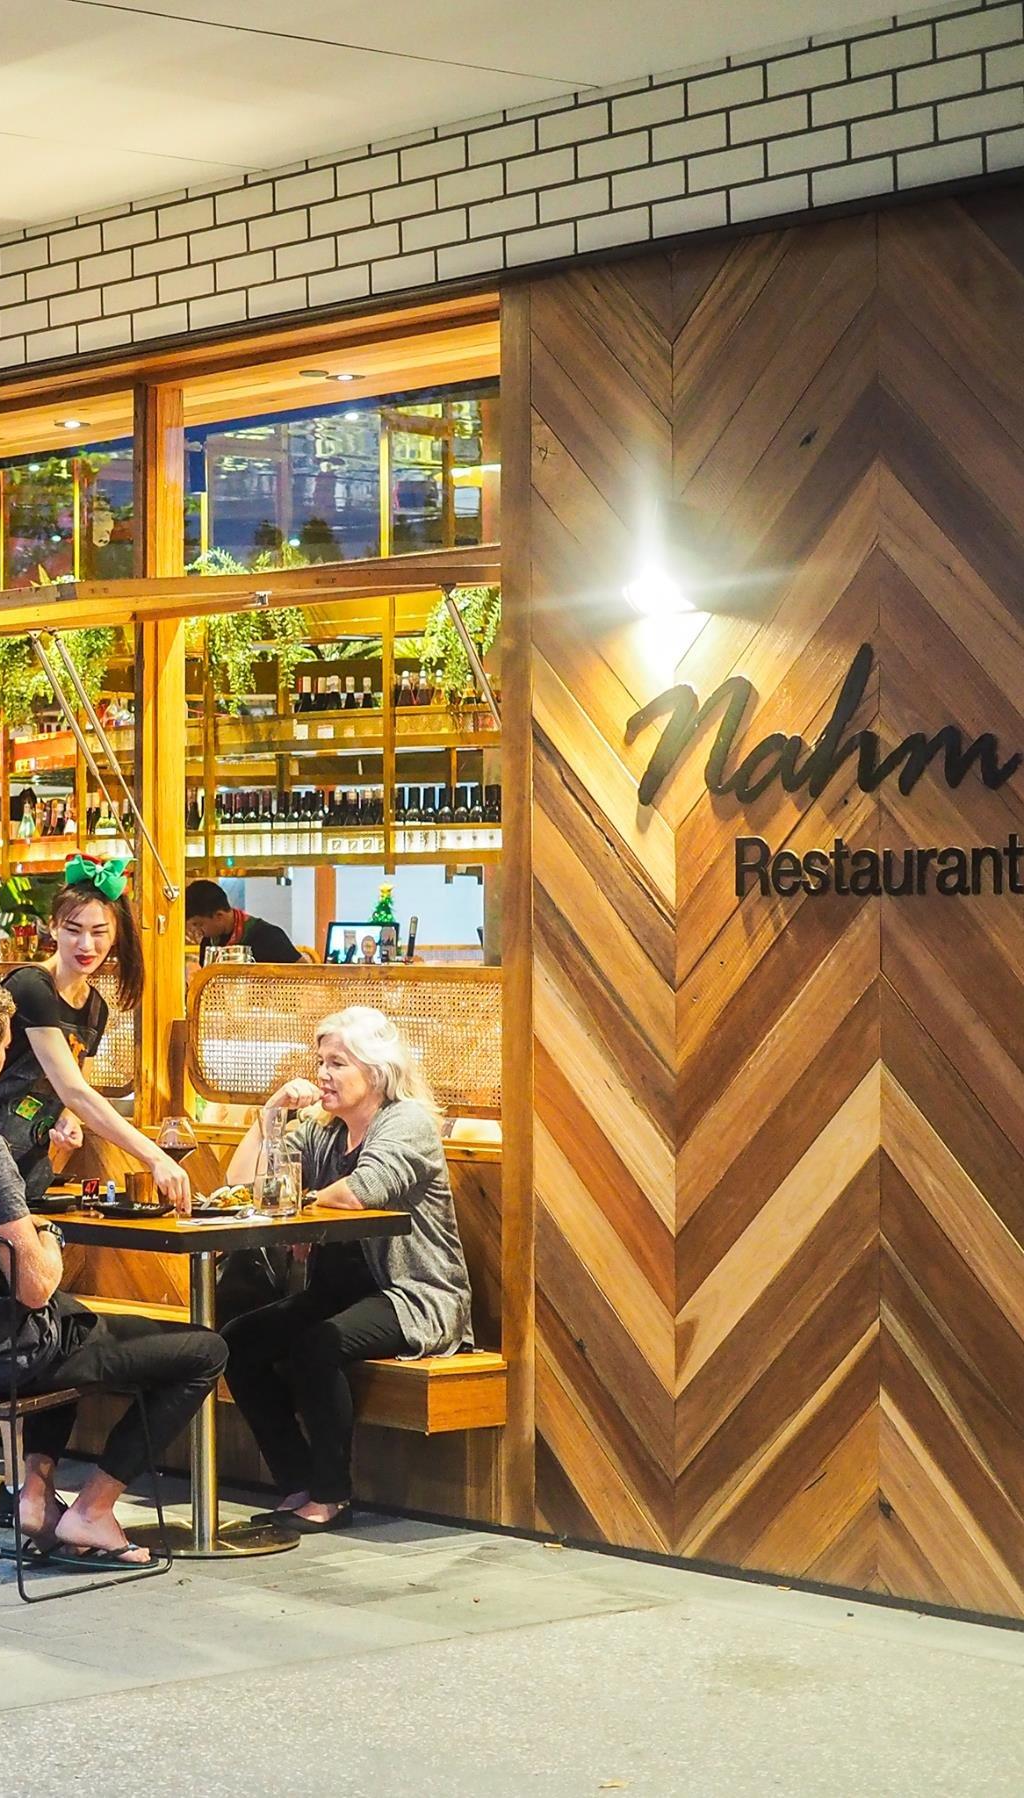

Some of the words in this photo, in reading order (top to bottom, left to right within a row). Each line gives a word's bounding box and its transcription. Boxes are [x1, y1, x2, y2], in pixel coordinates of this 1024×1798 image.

[625, 643, 1023, 805] Nahm
[735, 834, 1024, 897] Restaurant
[85, 1180, 97, 1193] 47
